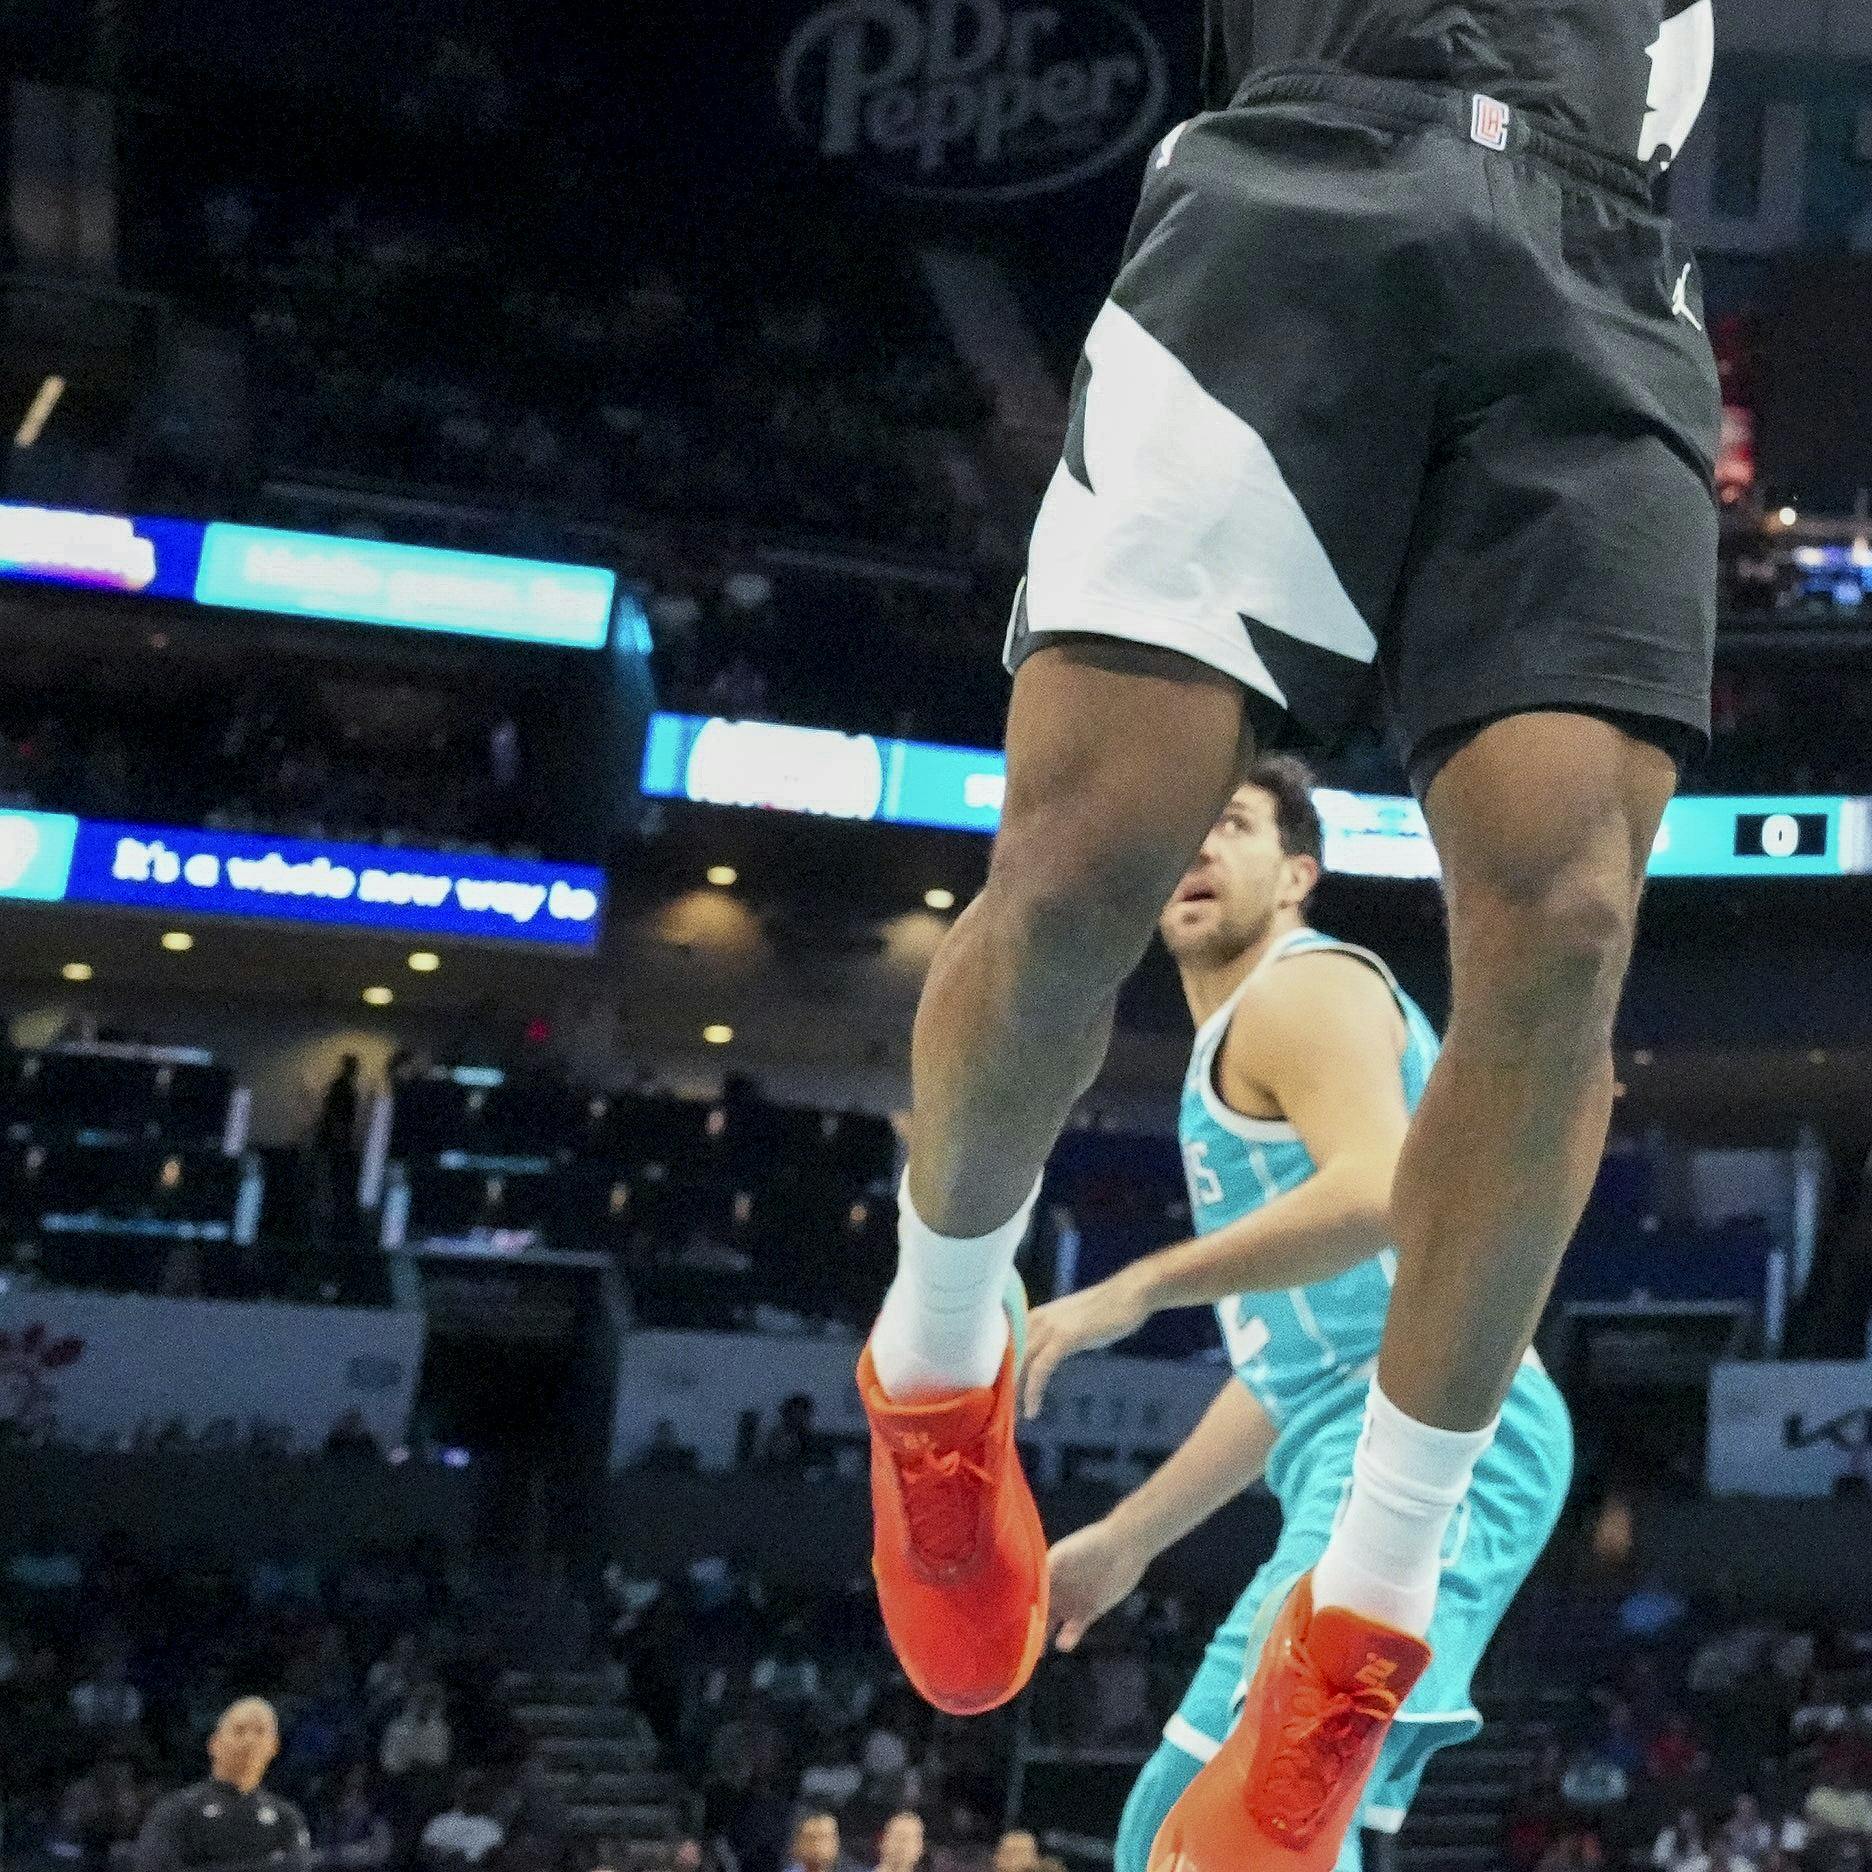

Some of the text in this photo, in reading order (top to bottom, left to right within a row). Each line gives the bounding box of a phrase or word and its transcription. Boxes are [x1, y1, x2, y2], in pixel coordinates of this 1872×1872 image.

[1761, 814, 1799, 858] 0
[184, 854, 220, 887] a
[227, 853, 356, 899] whole
[358, 869, 452, 906] new
[455, 878, 548, 922] way
[548, 880, 597, 921] to
